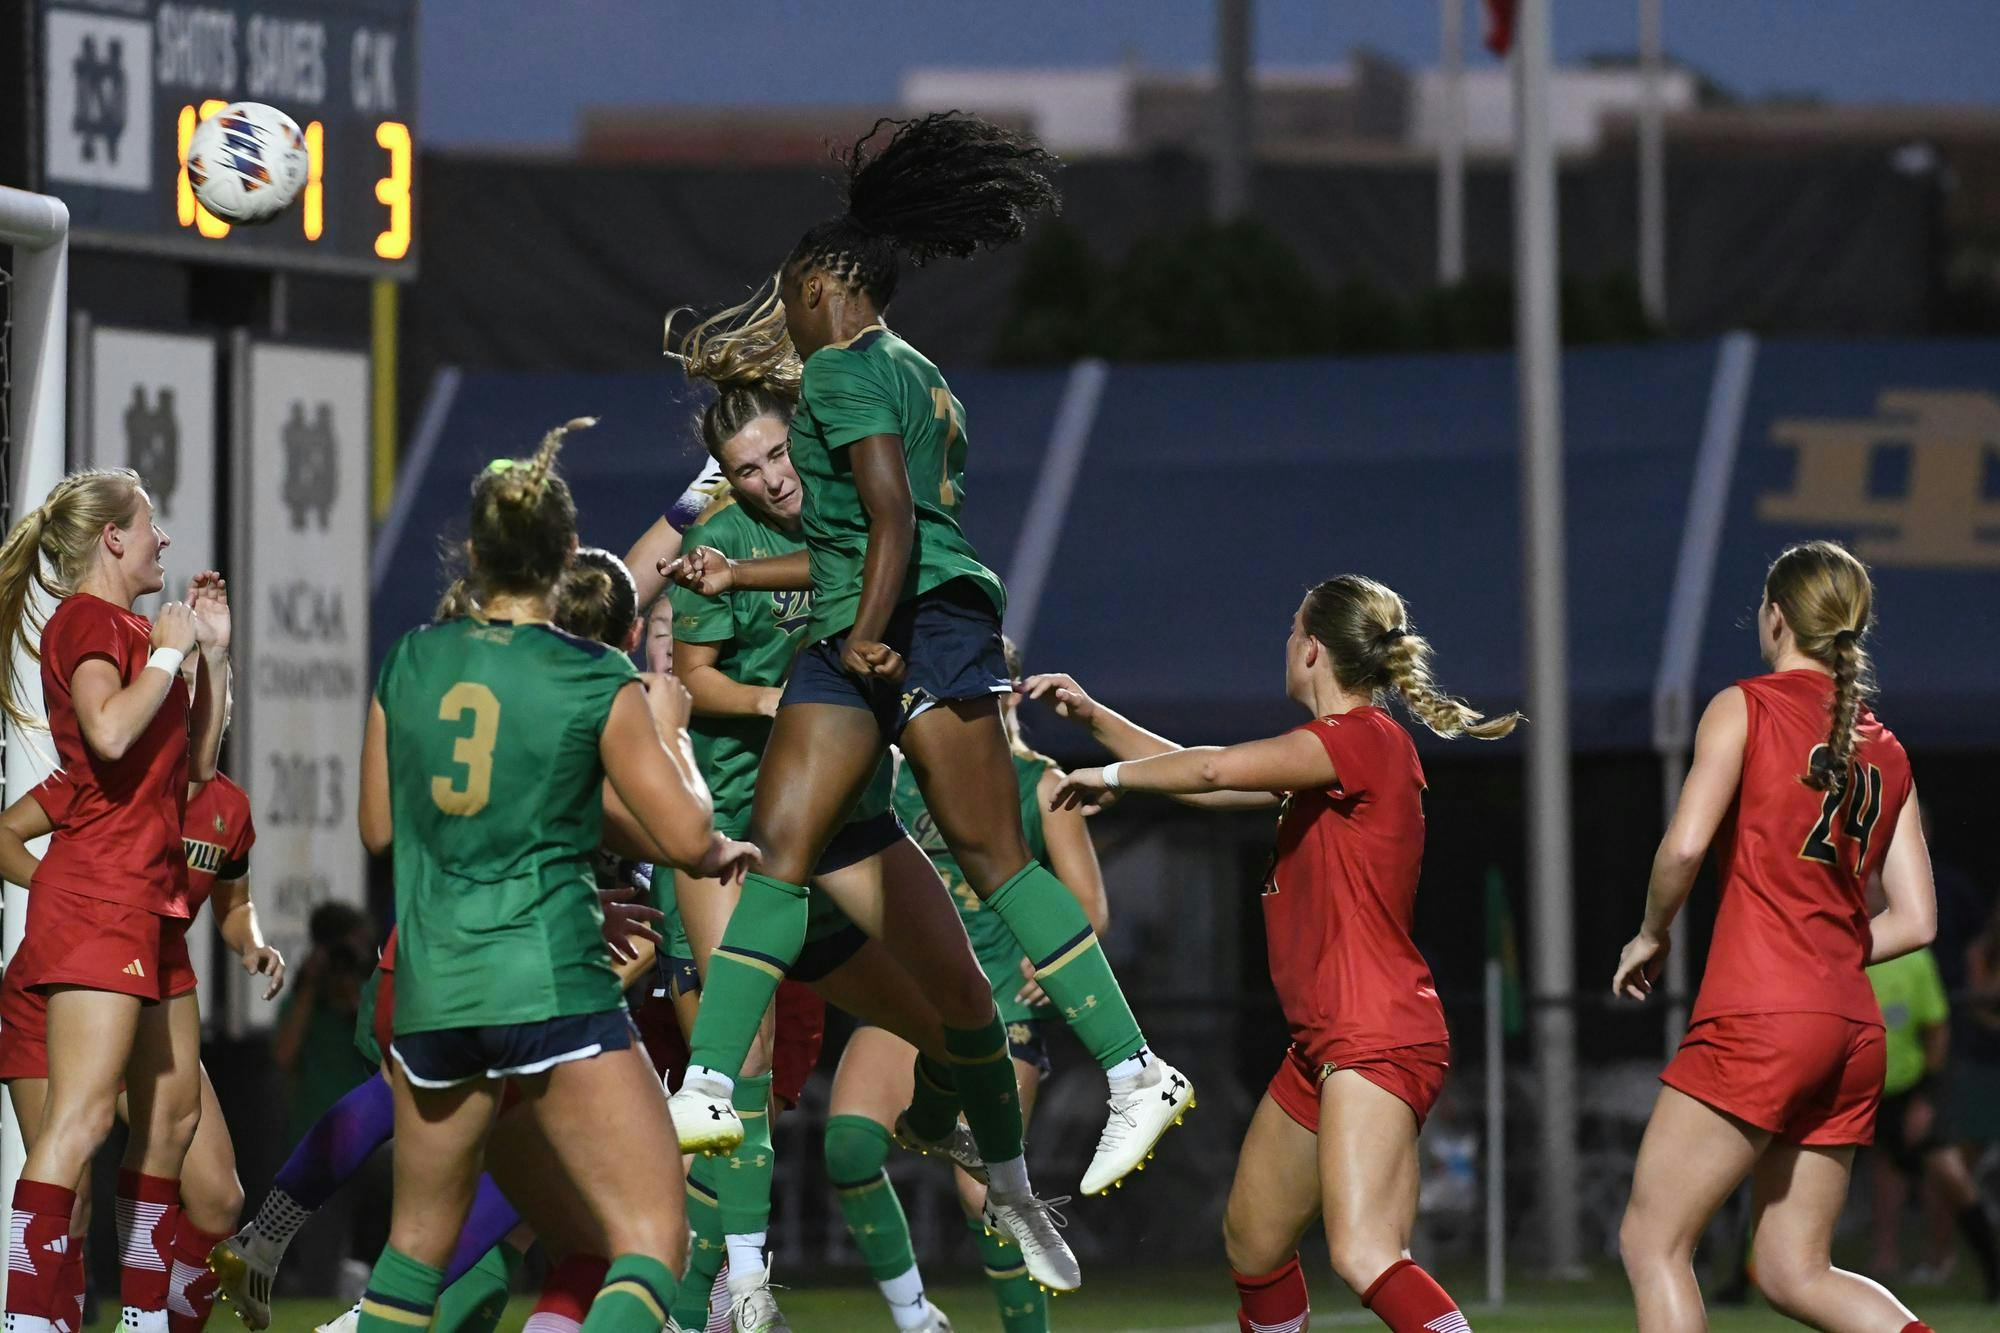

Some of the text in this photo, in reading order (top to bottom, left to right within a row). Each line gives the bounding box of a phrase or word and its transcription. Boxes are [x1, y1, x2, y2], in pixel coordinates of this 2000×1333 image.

[374, 121, 412, 260] 3
[431, 682, 501, 817] 3
[1798, 742, 1883, 879] 24
